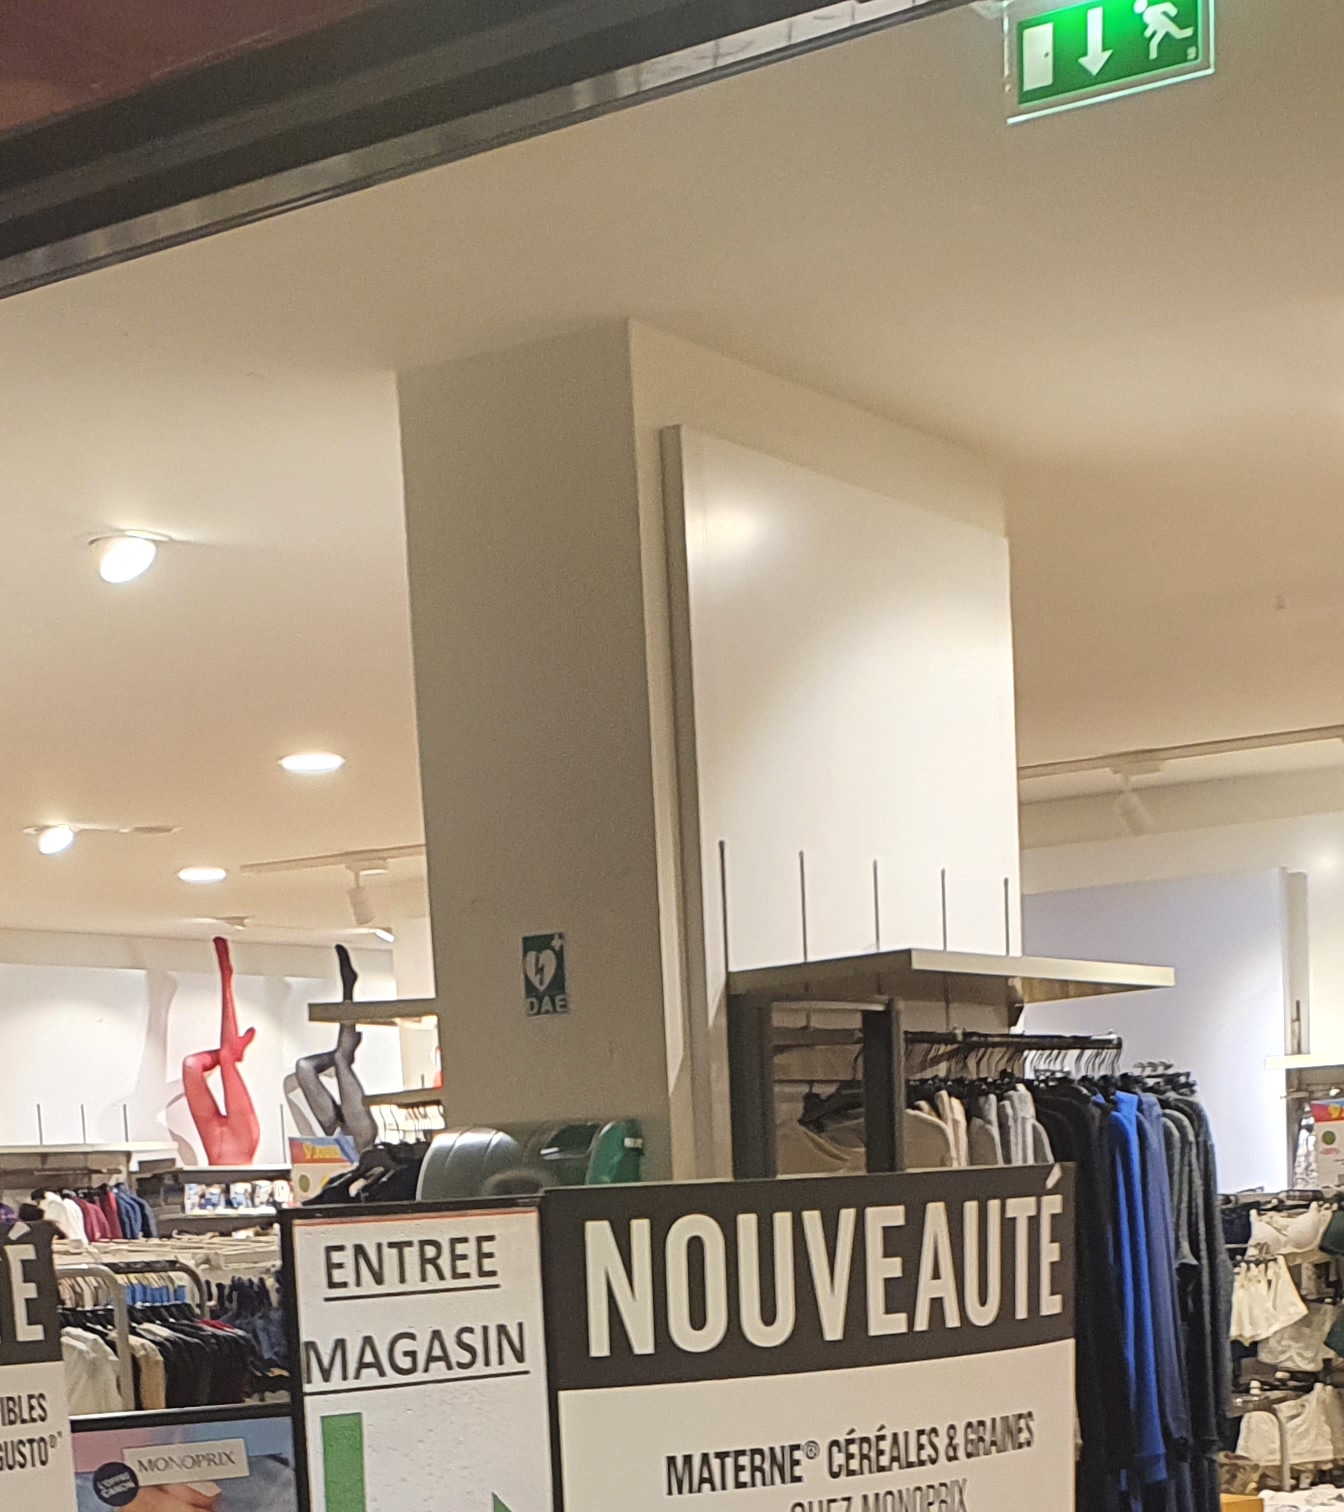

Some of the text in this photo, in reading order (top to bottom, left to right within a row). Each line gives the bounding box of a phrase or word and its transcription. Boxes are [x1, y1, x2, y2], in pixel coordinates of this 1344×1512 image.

[526, 995, 570, 1015] DAE
[324, 1233, 499, 1291] ENTREE
[585, 1166, 1063, 1358] NOUVEAUTÉ
[303, 1321, 527, 1385] MAGASIN
[137, 1450, 237, 1474] MONOPRIX
[827, 1423, 940, 1480] CÉRÉALES
[945, 1423, 960, 1463] &
[963, 1410, 1036, 1460] GRAINES
